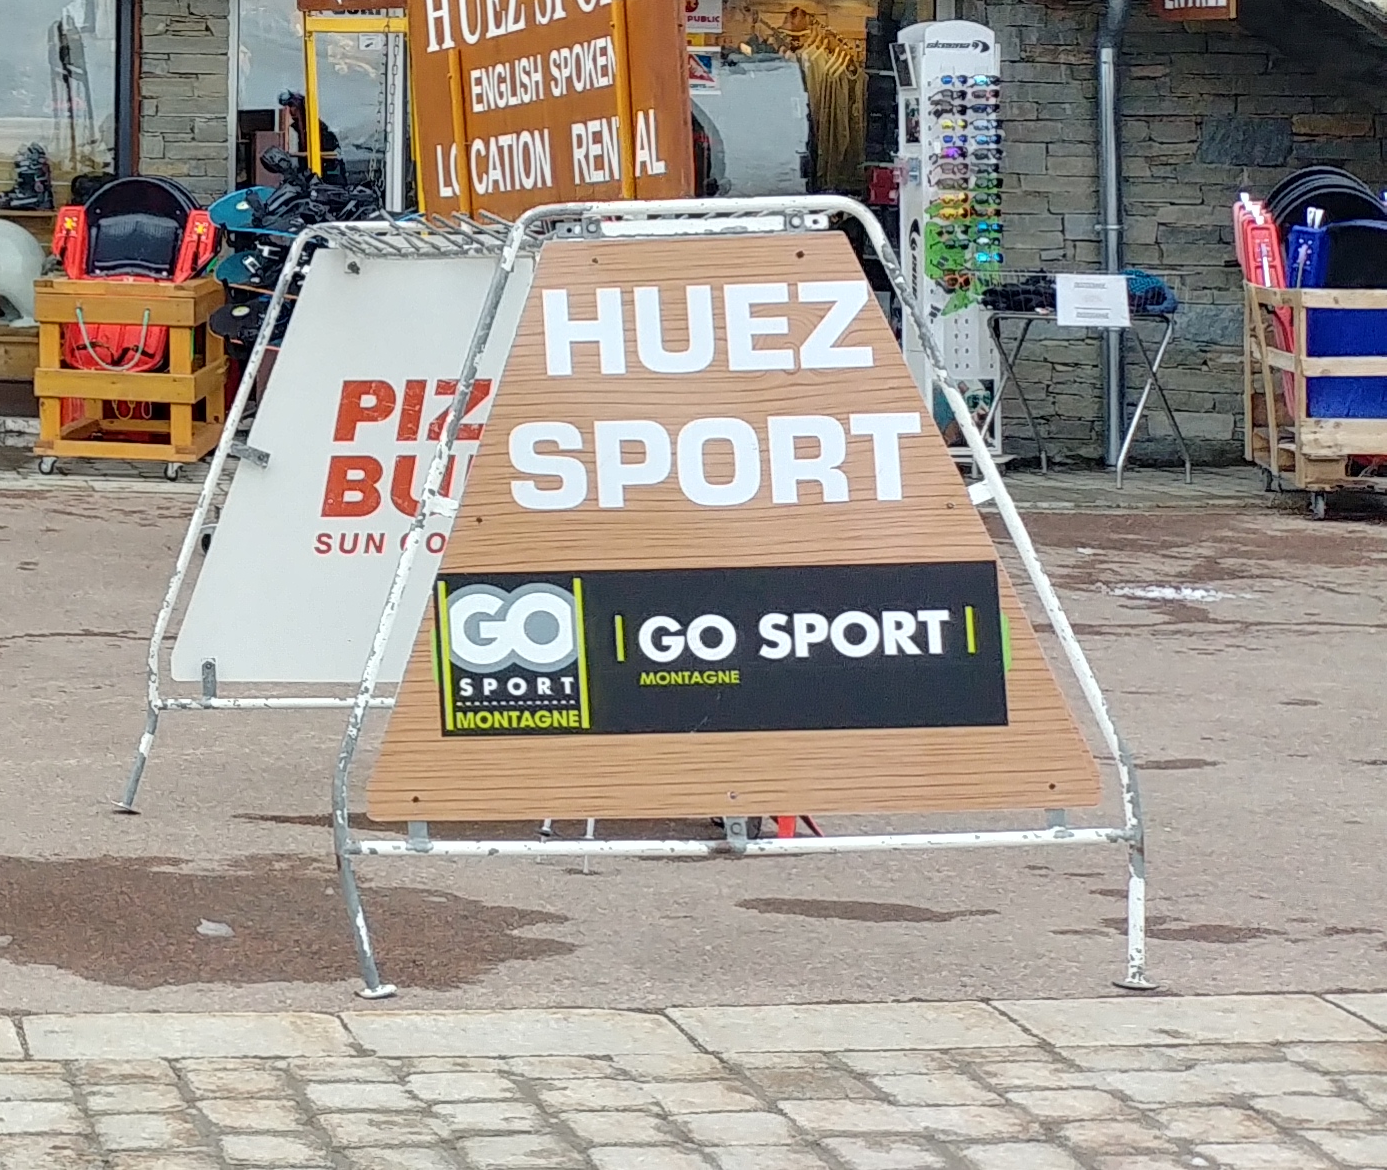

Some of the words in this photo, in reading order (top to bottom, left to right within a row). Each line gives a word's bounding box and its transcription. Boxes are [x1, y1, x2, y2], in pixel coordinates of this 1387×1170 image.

[686, 15, 721, 23] PUBLIC
[470, 54, 544, 113] ENGLISH
[571, 109, 667, 185] RENAL
[542, 281, 874, 376] HUEZ
[508, 412, 921, 510] SPORT
[314, 532, 386, 555] SUN
[447, 593, 574, 665] GO
[638, 614, 737, 663] GO
[758, 610, 951, 660] SPORT
[458, 676, 575, 697] SPORT
[639, 670, 741, 686] MONTAGNE
[455, 708, 581, 729] MONTAGNE
